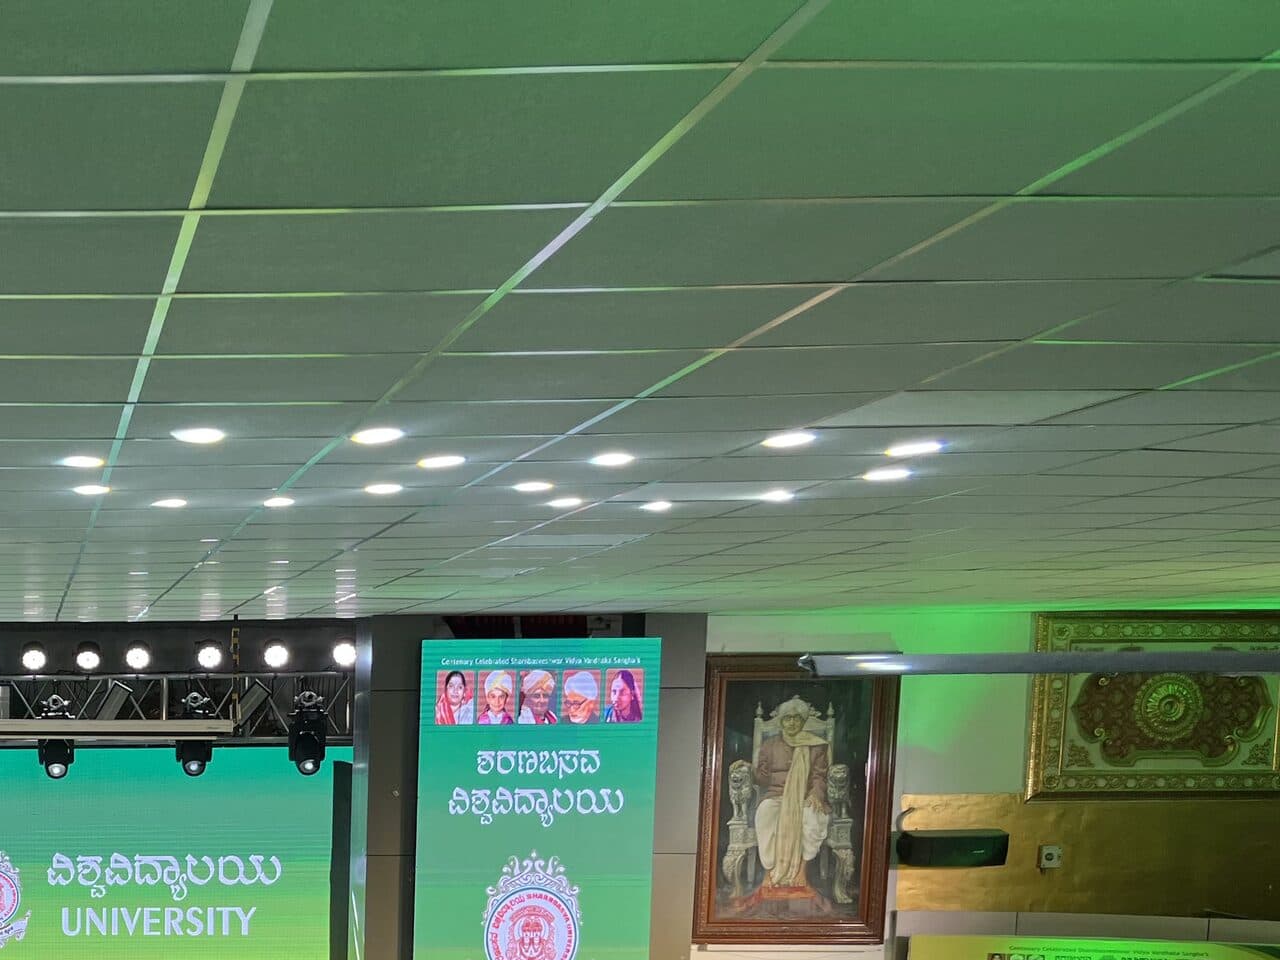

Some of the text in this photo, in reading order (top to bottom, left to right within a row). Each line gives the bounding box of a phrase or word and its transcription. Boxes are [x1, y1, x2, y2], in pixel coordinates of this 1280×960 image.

[477, 749, 601, 779] ಶರಣಬಸವ
[448, 786, 625, 828] ವಿಶ್ವವಿದ್ಯಾಲಯ
[46, 852, 282, 901] ವಿಶ್ವವಿದ್ಯಾಲಯ
[60, 906, 257, 936] UNIVERSITY
